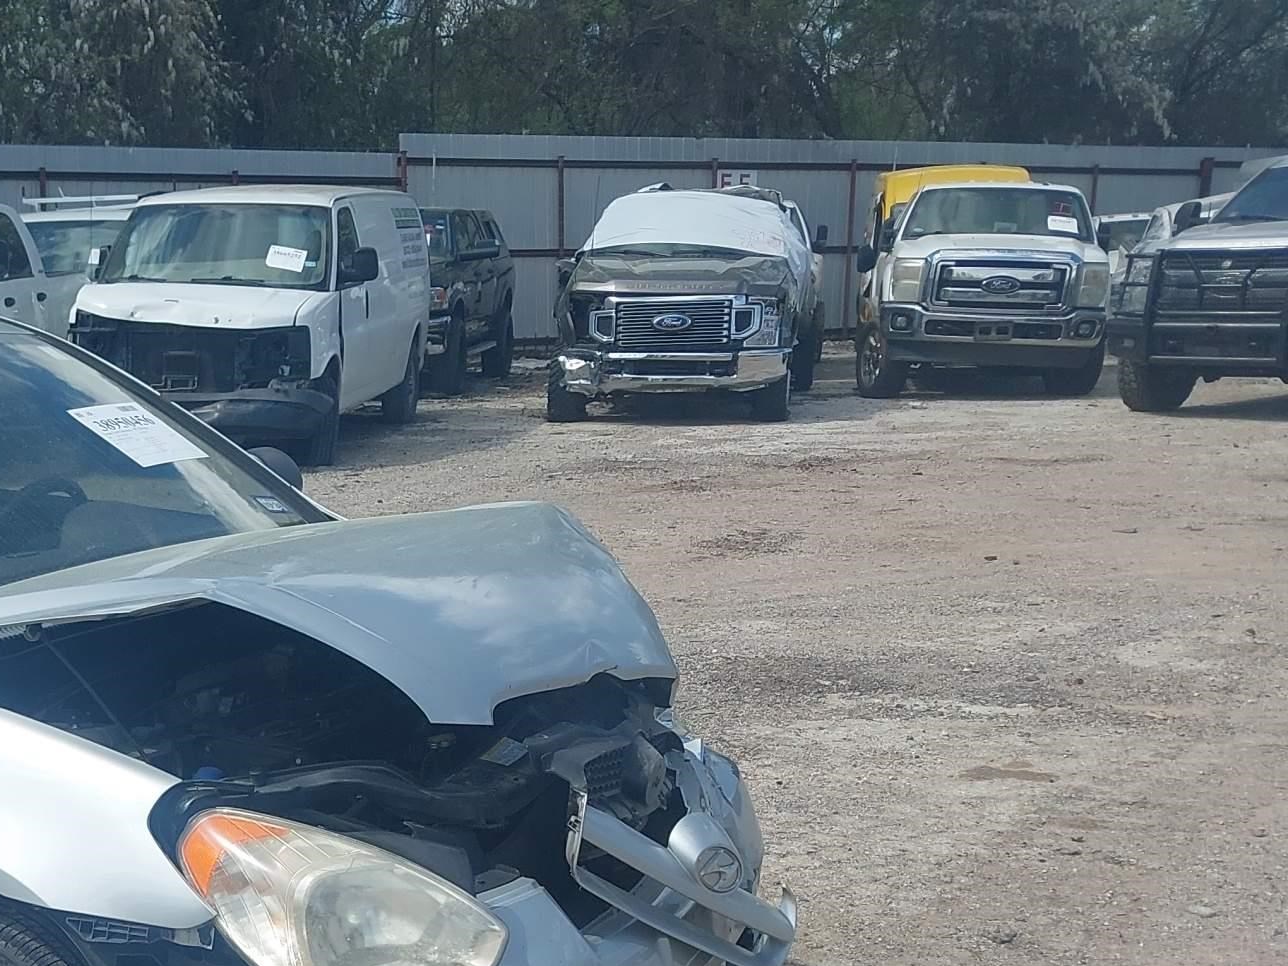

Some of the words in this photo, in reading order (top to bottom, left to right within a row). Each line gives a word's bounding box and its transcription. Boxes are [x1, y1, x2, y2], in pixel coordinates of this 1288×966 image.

[991, 280, 1012, 289] Ford
[661, 317, 683, 327] Ford
[92, 414, 157, 432] 38950456
